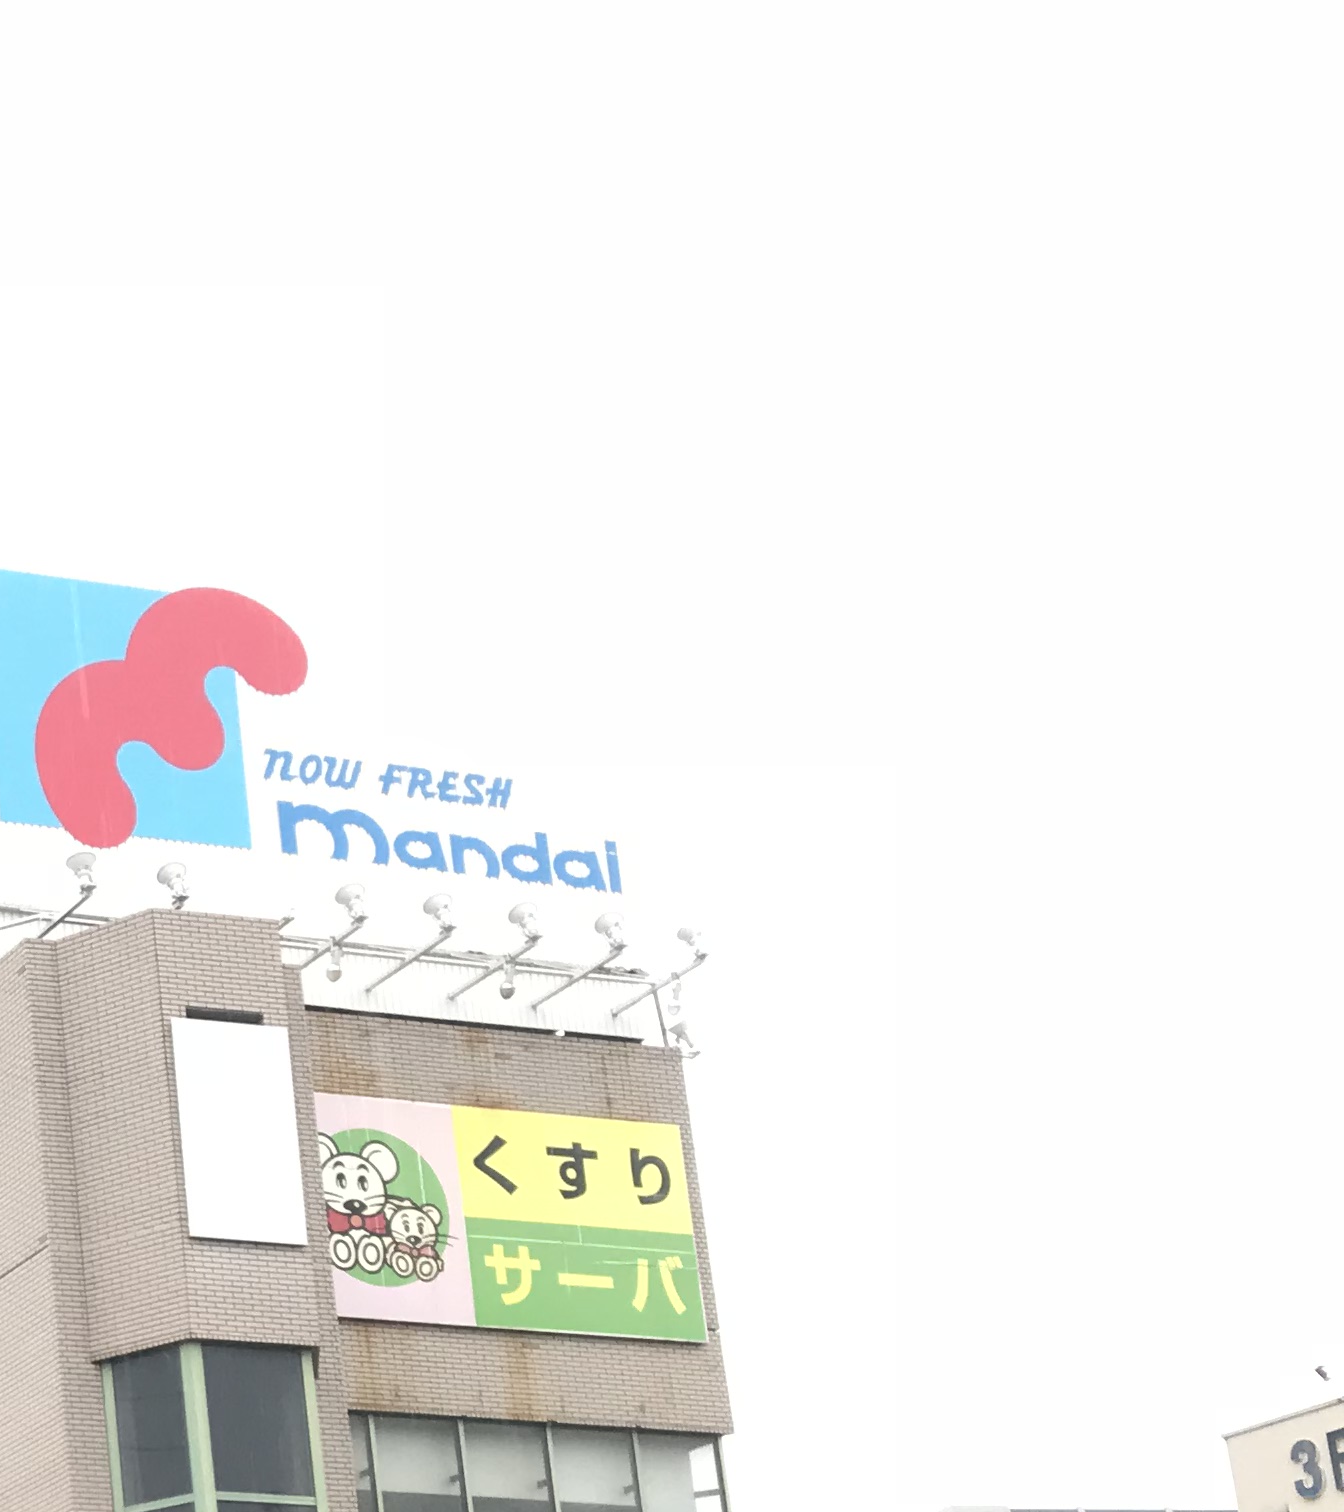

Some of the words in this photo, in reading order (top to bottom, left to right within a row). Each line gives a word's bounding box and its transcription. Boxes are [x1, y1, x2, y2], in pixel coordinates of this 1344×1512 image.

[378, 762, 514, 810] FRESH
[275, 799, 623, 895] mandai
[472, 1134, 673, 1206] くすり
[483, 1243, 688, 1316] サーバ
